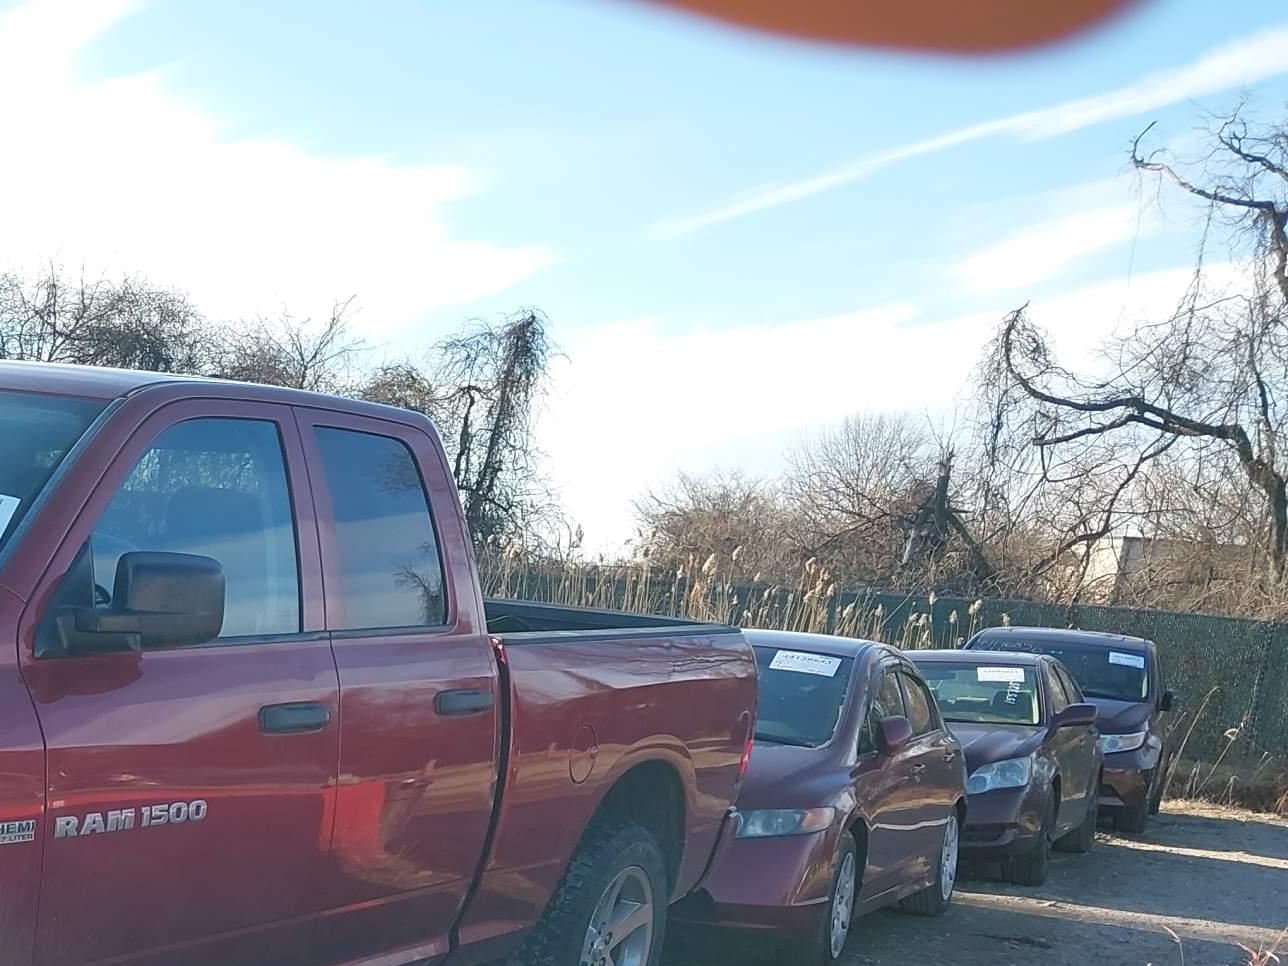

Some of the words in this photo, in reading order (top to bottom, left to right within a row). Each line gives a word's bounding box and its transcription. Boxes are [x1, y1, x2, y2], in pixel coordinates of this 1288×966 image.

[53, 807, 136, 839] RAM
[140, 799, 209, 828] 1500
[8, 833, 33, 842] LITER
